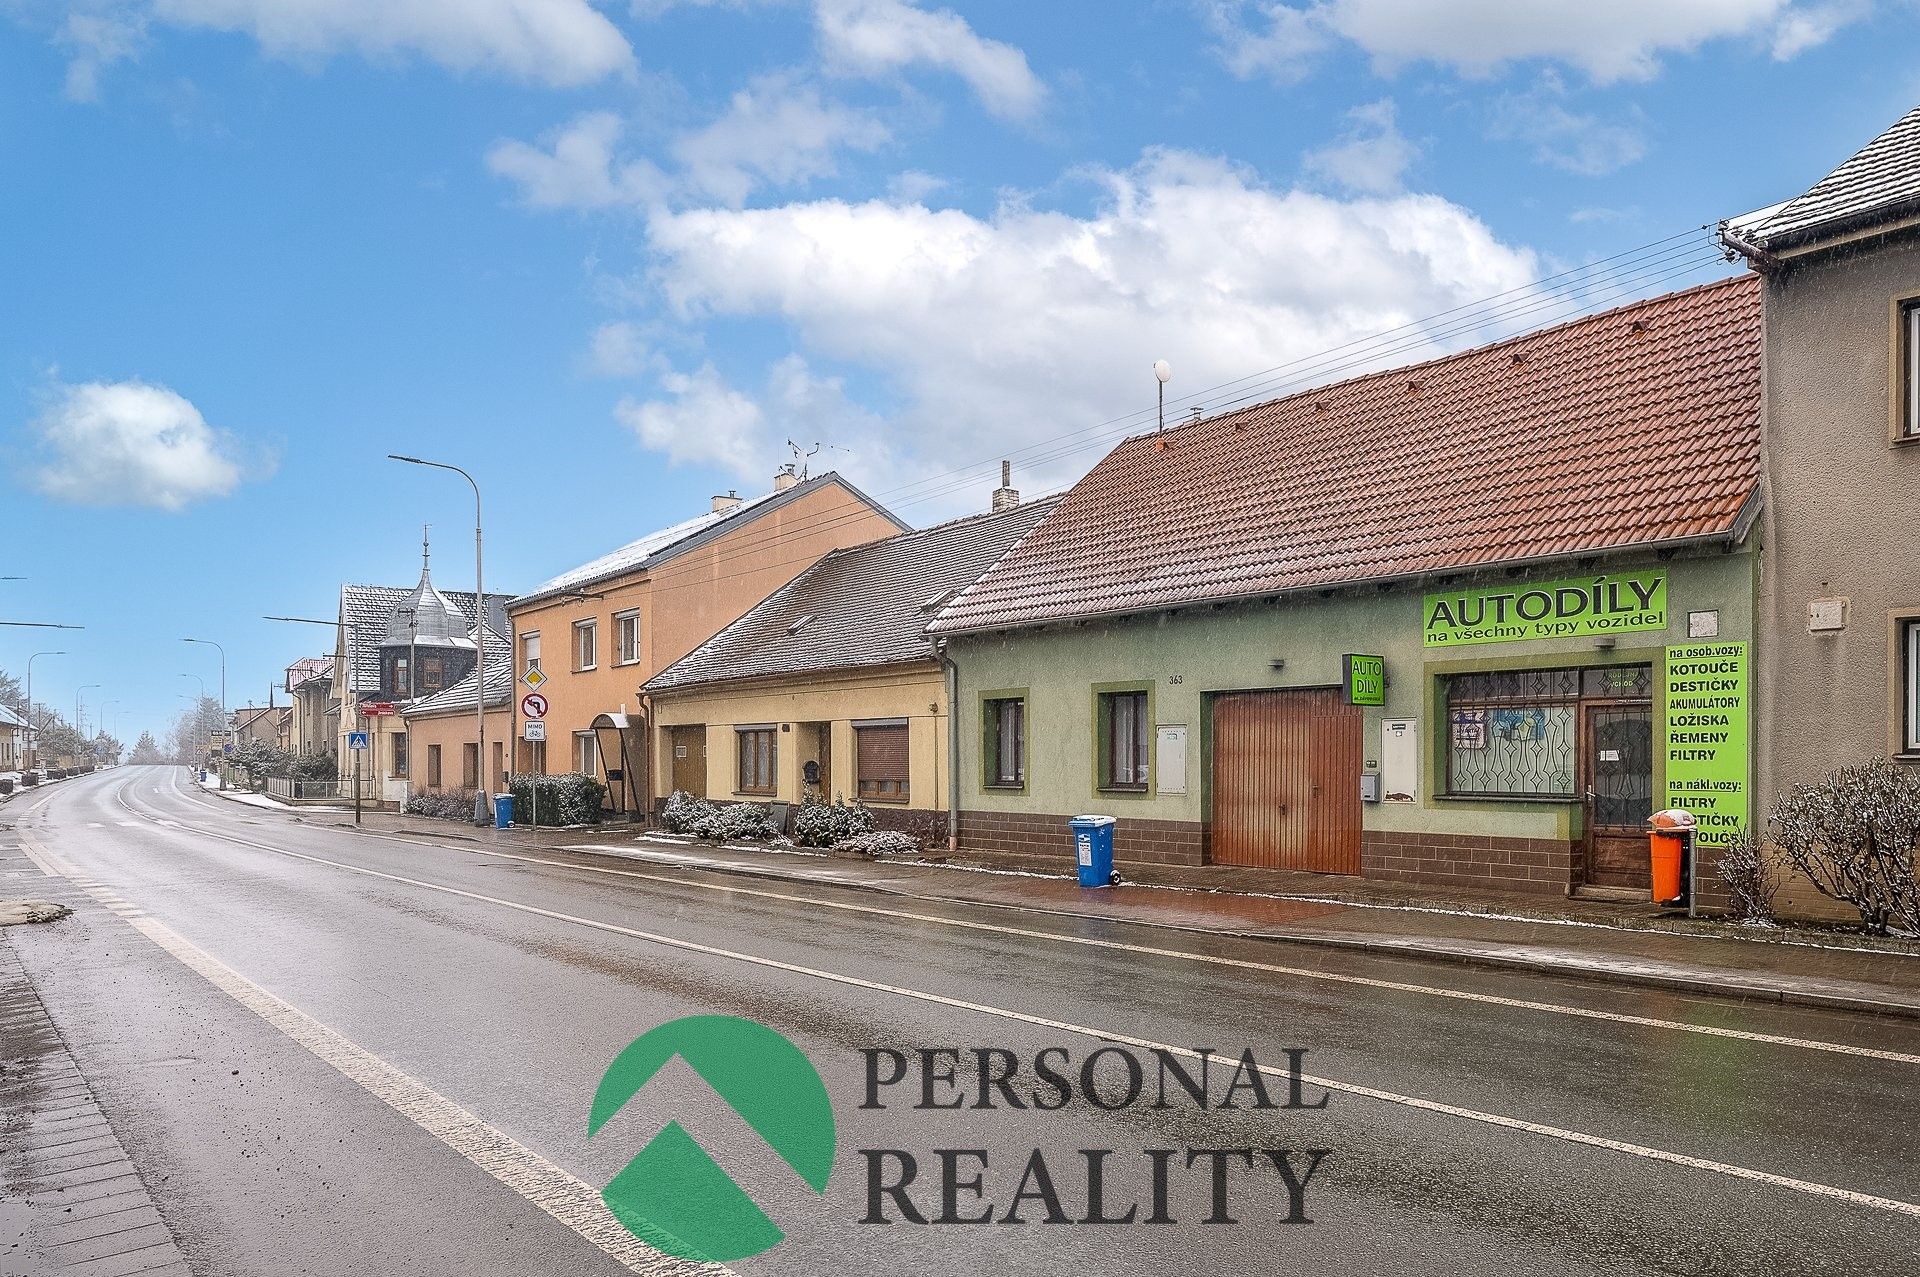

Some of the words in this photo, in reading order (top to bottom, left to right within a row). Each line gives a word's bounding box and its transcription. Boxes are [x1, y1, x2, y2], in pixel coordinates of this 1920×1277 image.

[1427, 576, 1664, 629] AUTODÍLY
[1427, 631, 1448, 642] na
[1454, 625, 1528, 640] všechny
[1535, 621, 1579, 637] typy
[1586, 612, 1664, 630] vozidel
[1669, 649, 1683, 658] na
[1686, 646, 1743, 657] osob.vozy:
[1353, 661, 1381, 676] AUTO
[1670, 659, 1738, 675] KOTOUČE
[1169, 675, 1183, 685] 363
[1357, 676, 1378, 694] DÍLY
[1670, 677, 1739, 692] DESTIČKY
[1669, 695, 1740, 709] AKUMULÁTORY
[1670, 712, 1729, 726] LOŽISKA
[1670, 730, 1728, 743] ŘEMENY
[1670, 750, 1716, 760] FILTRY
[1669, 780, 1683, 790] na
[1686, 778, 1742, 792] nákl.vozy:
[1671, 797, 1717, 808] FILTRY
[1693, 812, 1739, 826] TIČKY
